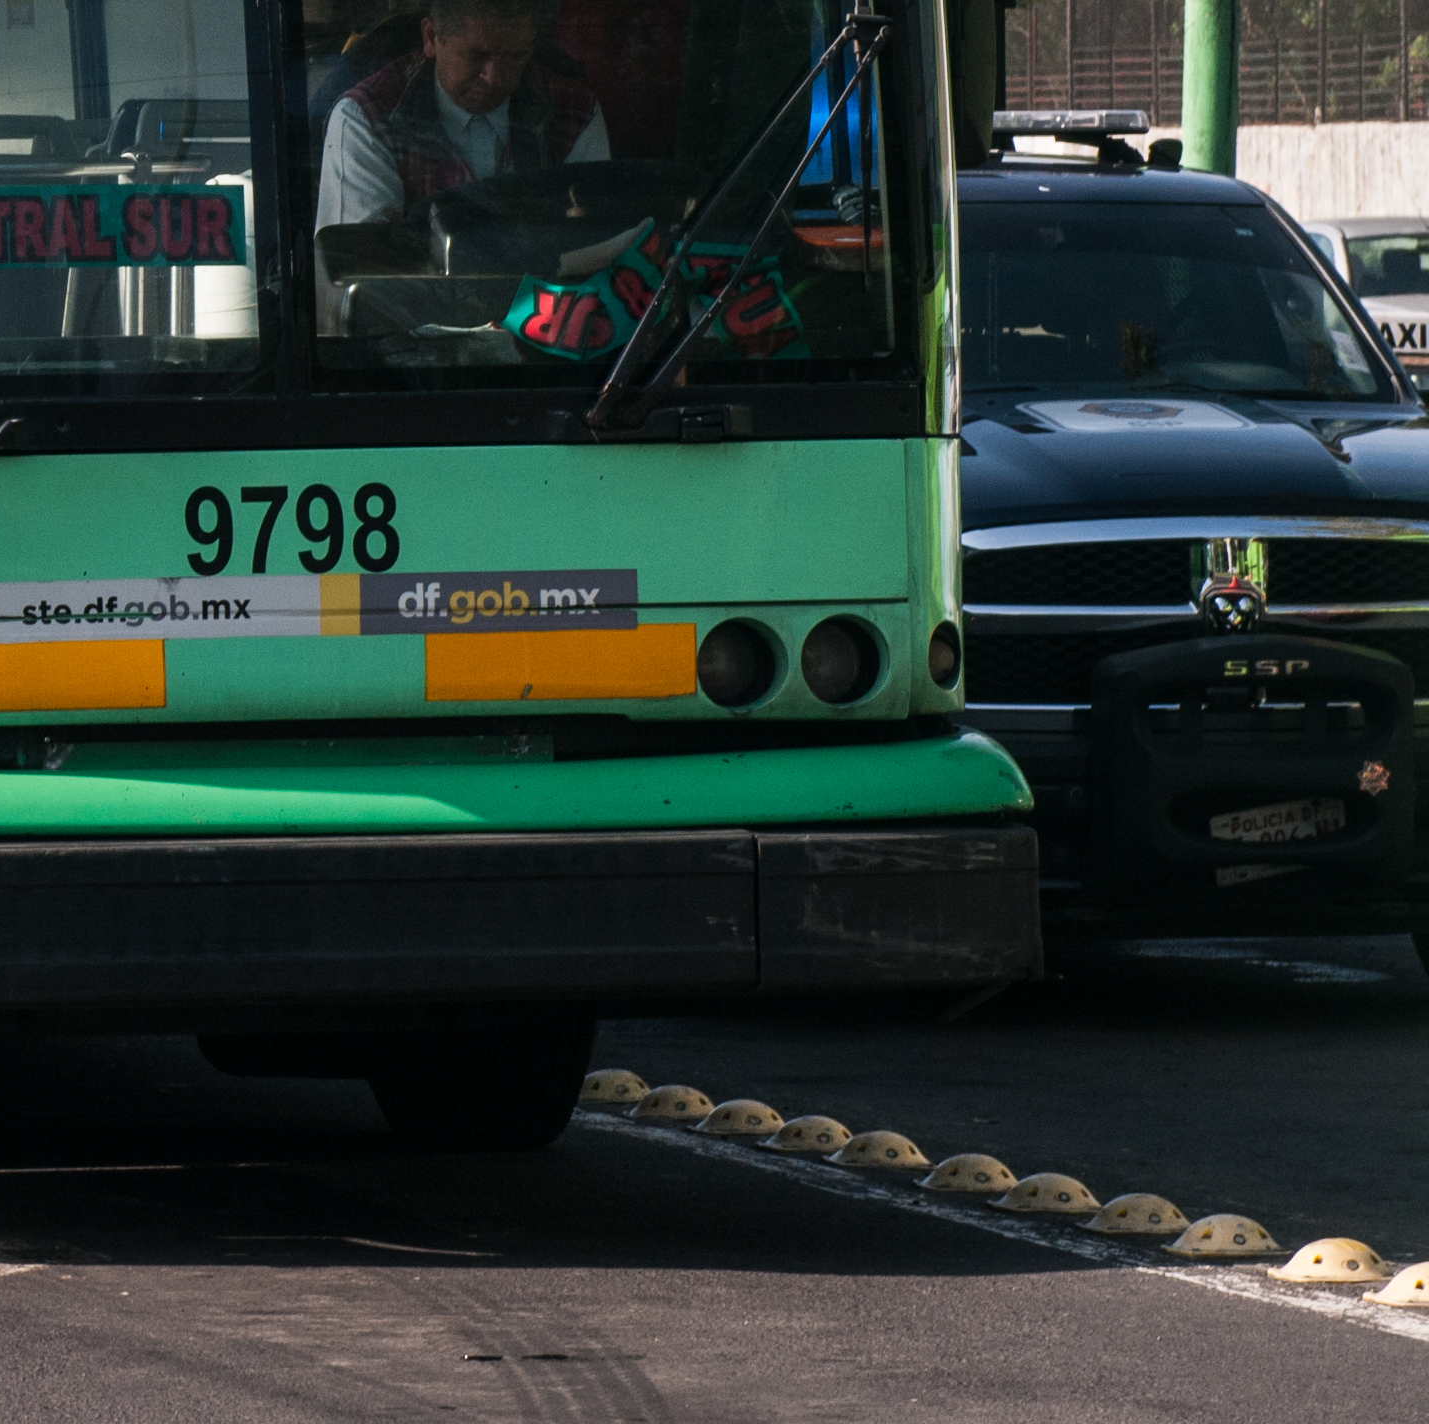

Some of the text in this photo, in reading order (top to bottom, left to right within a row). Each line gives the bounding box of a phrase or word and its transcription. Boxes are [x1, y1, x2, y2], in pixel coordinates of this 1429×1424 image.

[124, 195, 235, 263] SUR
[184, 481, 401, 577] 9798
[22, 594, 251, 627] ste.df.gob.mx
[397, 580, 601, 624] df.gob.mx
[1224, 659, 1310, 677] SSP
[1231, 809, 1295, 834] POLICIA
